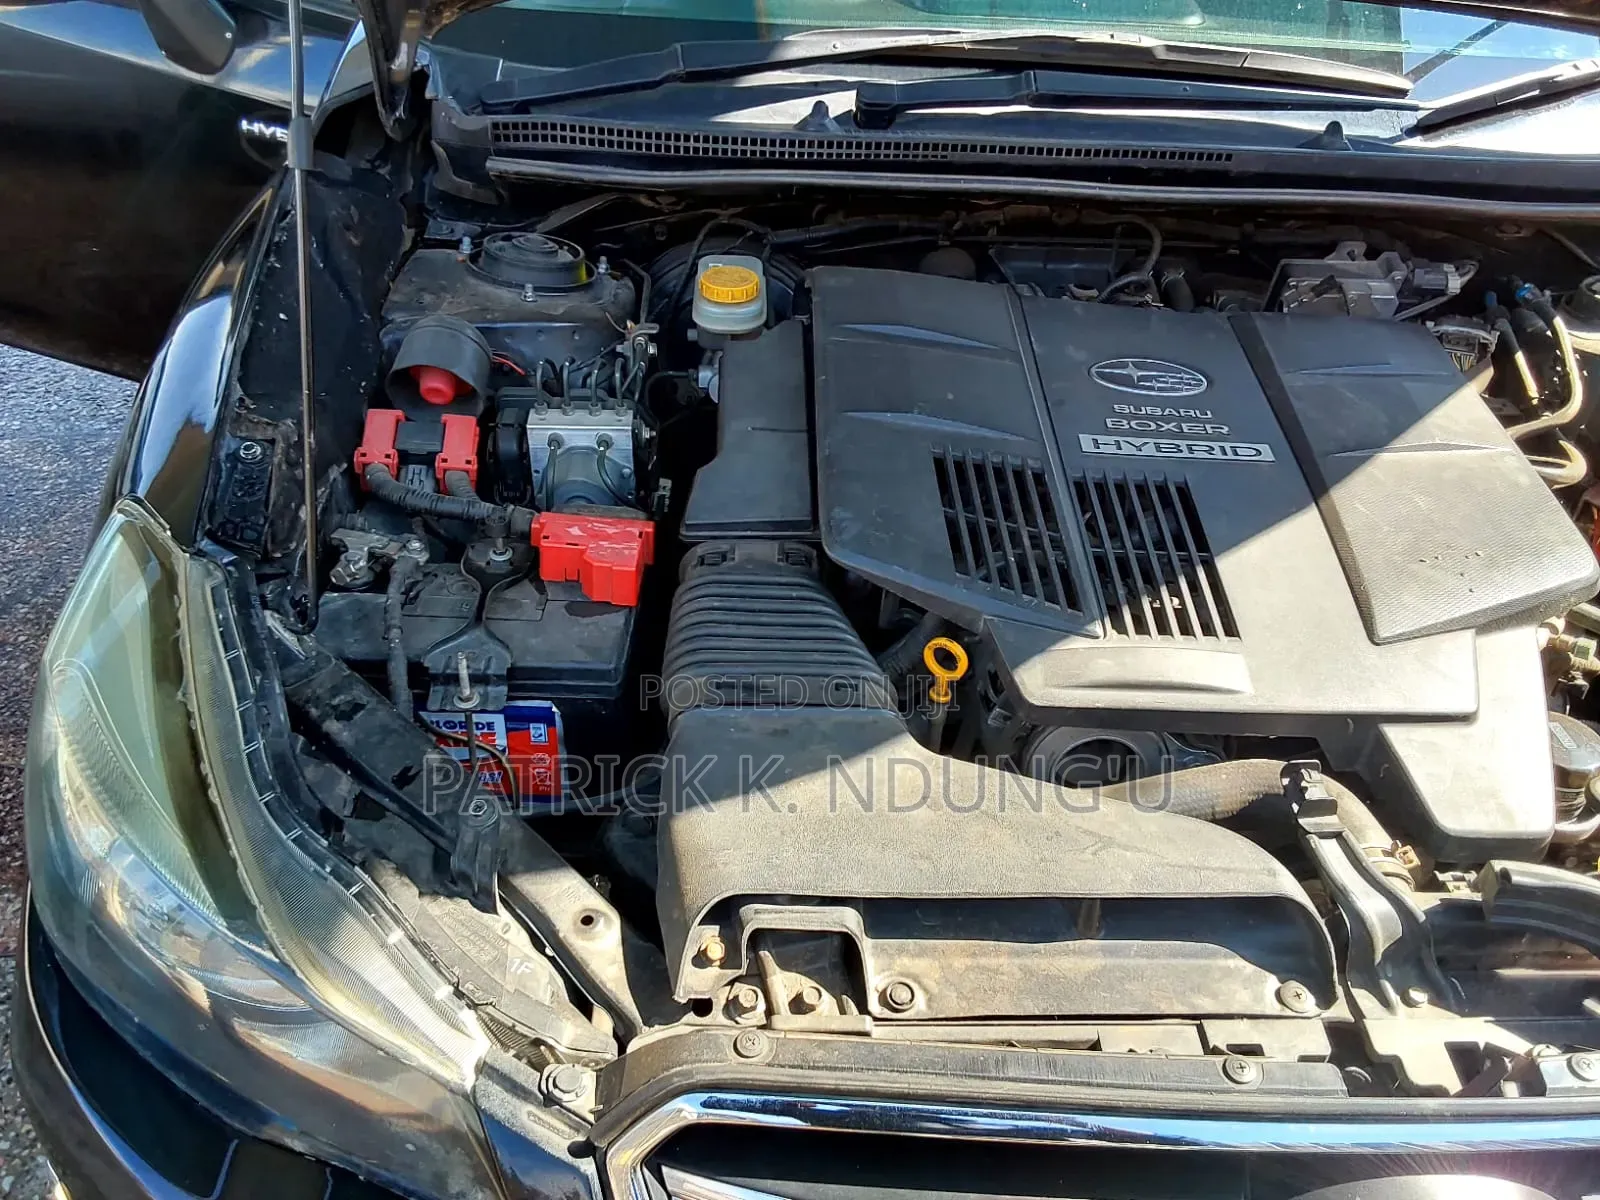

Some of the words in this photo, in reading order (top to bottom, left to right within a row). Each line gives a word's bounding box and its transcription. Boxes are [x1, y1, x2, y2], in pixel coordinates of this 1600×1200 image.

[1113, 404, 1212, 419] SUBARU
[1105, 418, 1230, 435] BOXER
[1092, 438, 1262, 458] HYBRID
